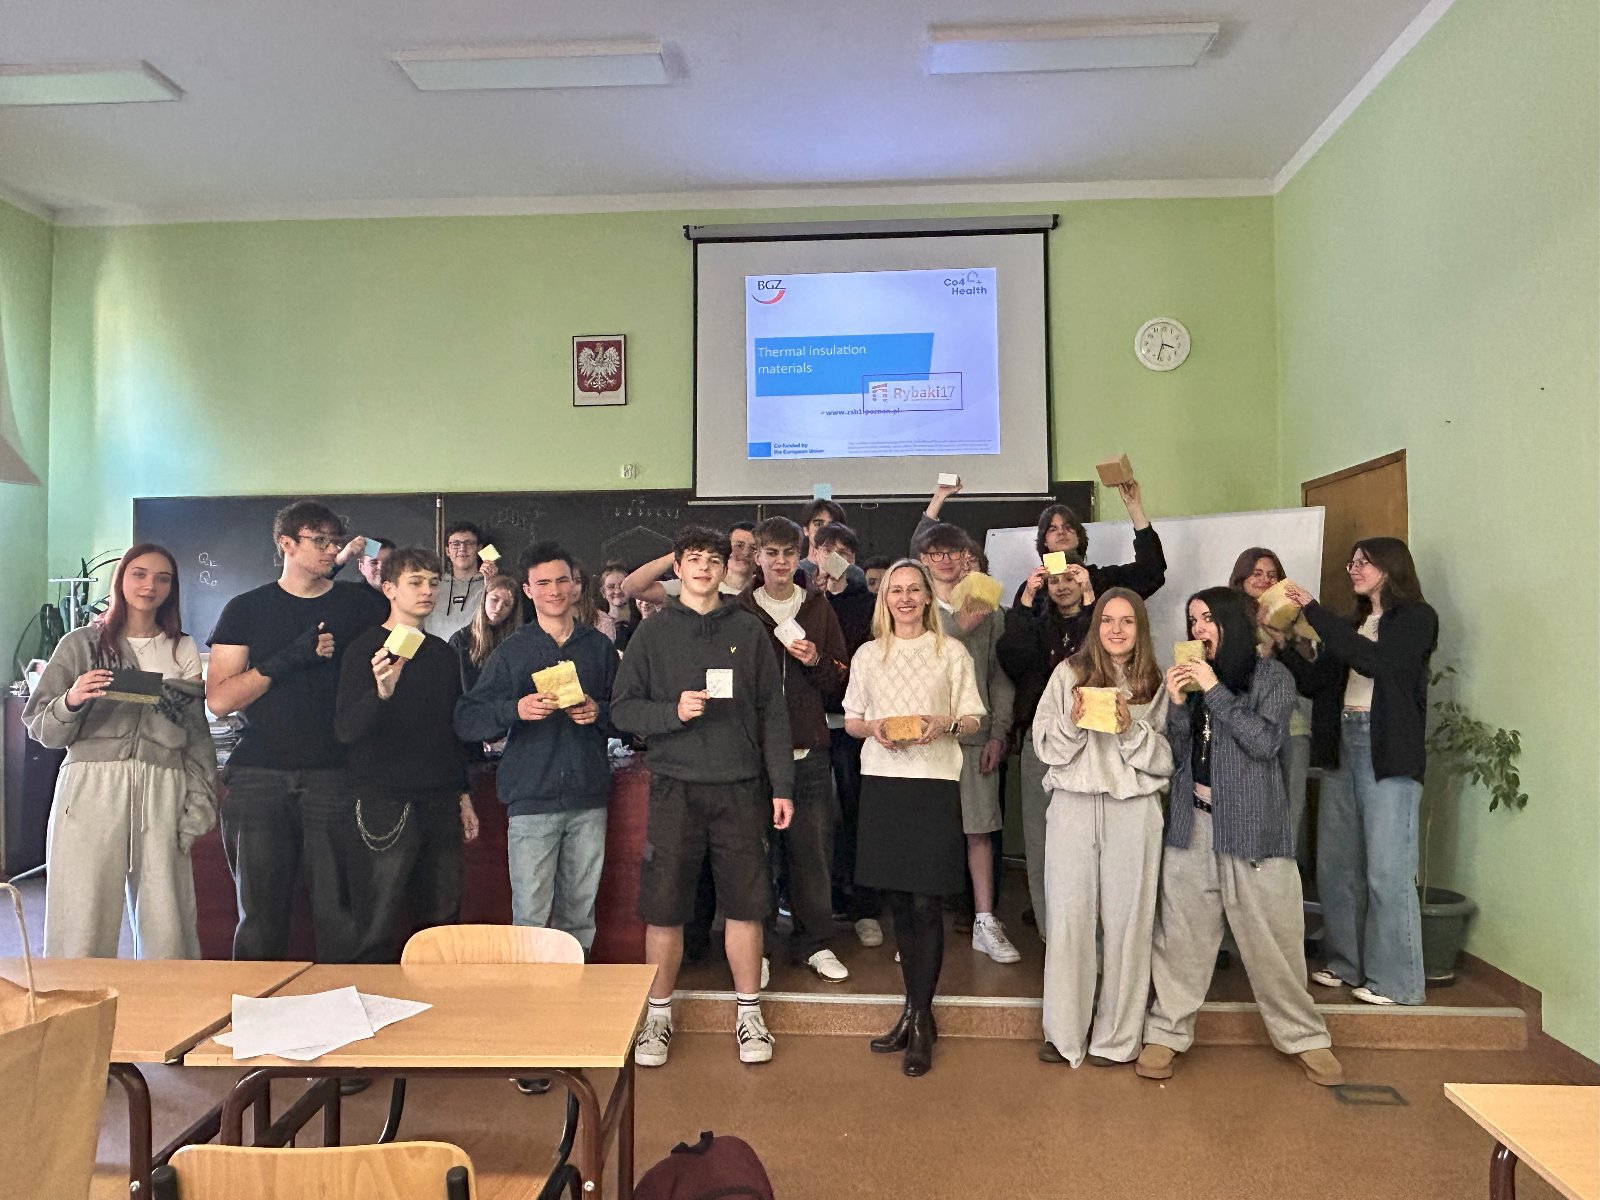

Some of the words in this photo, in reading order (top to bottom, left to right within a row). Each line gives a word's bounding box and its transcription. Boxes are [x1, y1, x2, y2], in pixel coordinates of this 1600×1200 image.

[757, 279, 786, 290] BGZ
[943, 278, 965, 287] Co4
[951, 286, 987, 295] Health
[757, 345, 806, 358] Thermal
[809, 344, 867, 356] insulation
[758, 362, 812, 374] materials
[893, 385, 956, 402] Rybaki17
[825, 407, 900, 416] www.zsb1poznan.pl
